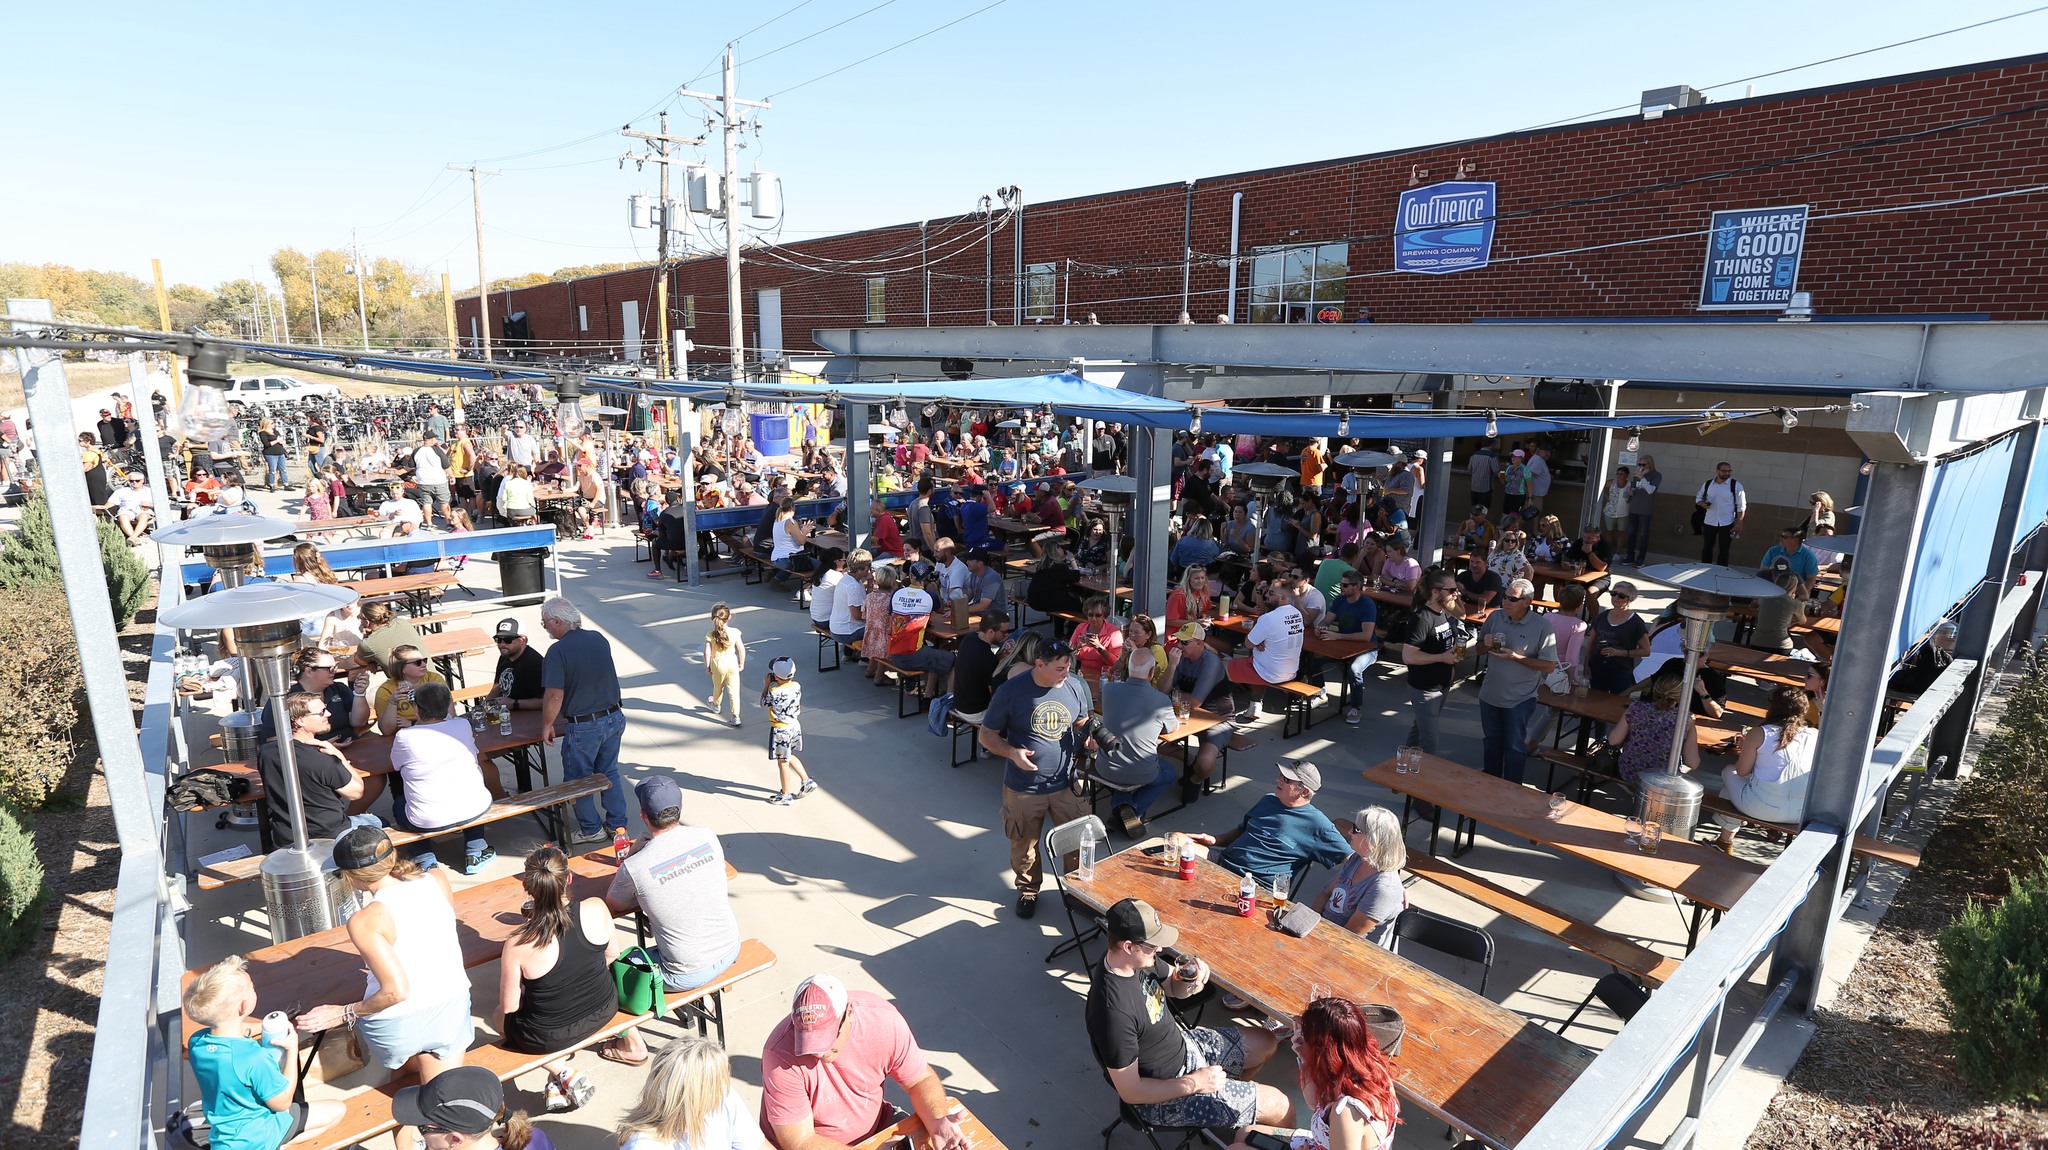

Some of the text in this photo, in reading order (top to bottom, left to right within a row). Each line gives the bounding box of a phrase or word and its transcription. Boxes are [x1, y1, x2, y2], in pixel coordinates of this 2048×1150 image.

[1404, 191, 1487, 231] Confluence
[1741, 213, 1802, 233] WHERE
[1736, 232, 1799, 257] GOOD
[1402, 249, 1439, 257] BREWING
[1714, 257, 1774, 276] THINGS
[1734, 275, 1771, 289] COME
[1732, 289, 1790, 302] TOGETHER
[1320, 310, 1341, 321] OPEN
[898, 596, 915, 604] FOLLOW
[1046, 711, 1059, 730] 10
[658, 854, 714, 885] patagonia
[808, 1003, 827, 1011] STATE
